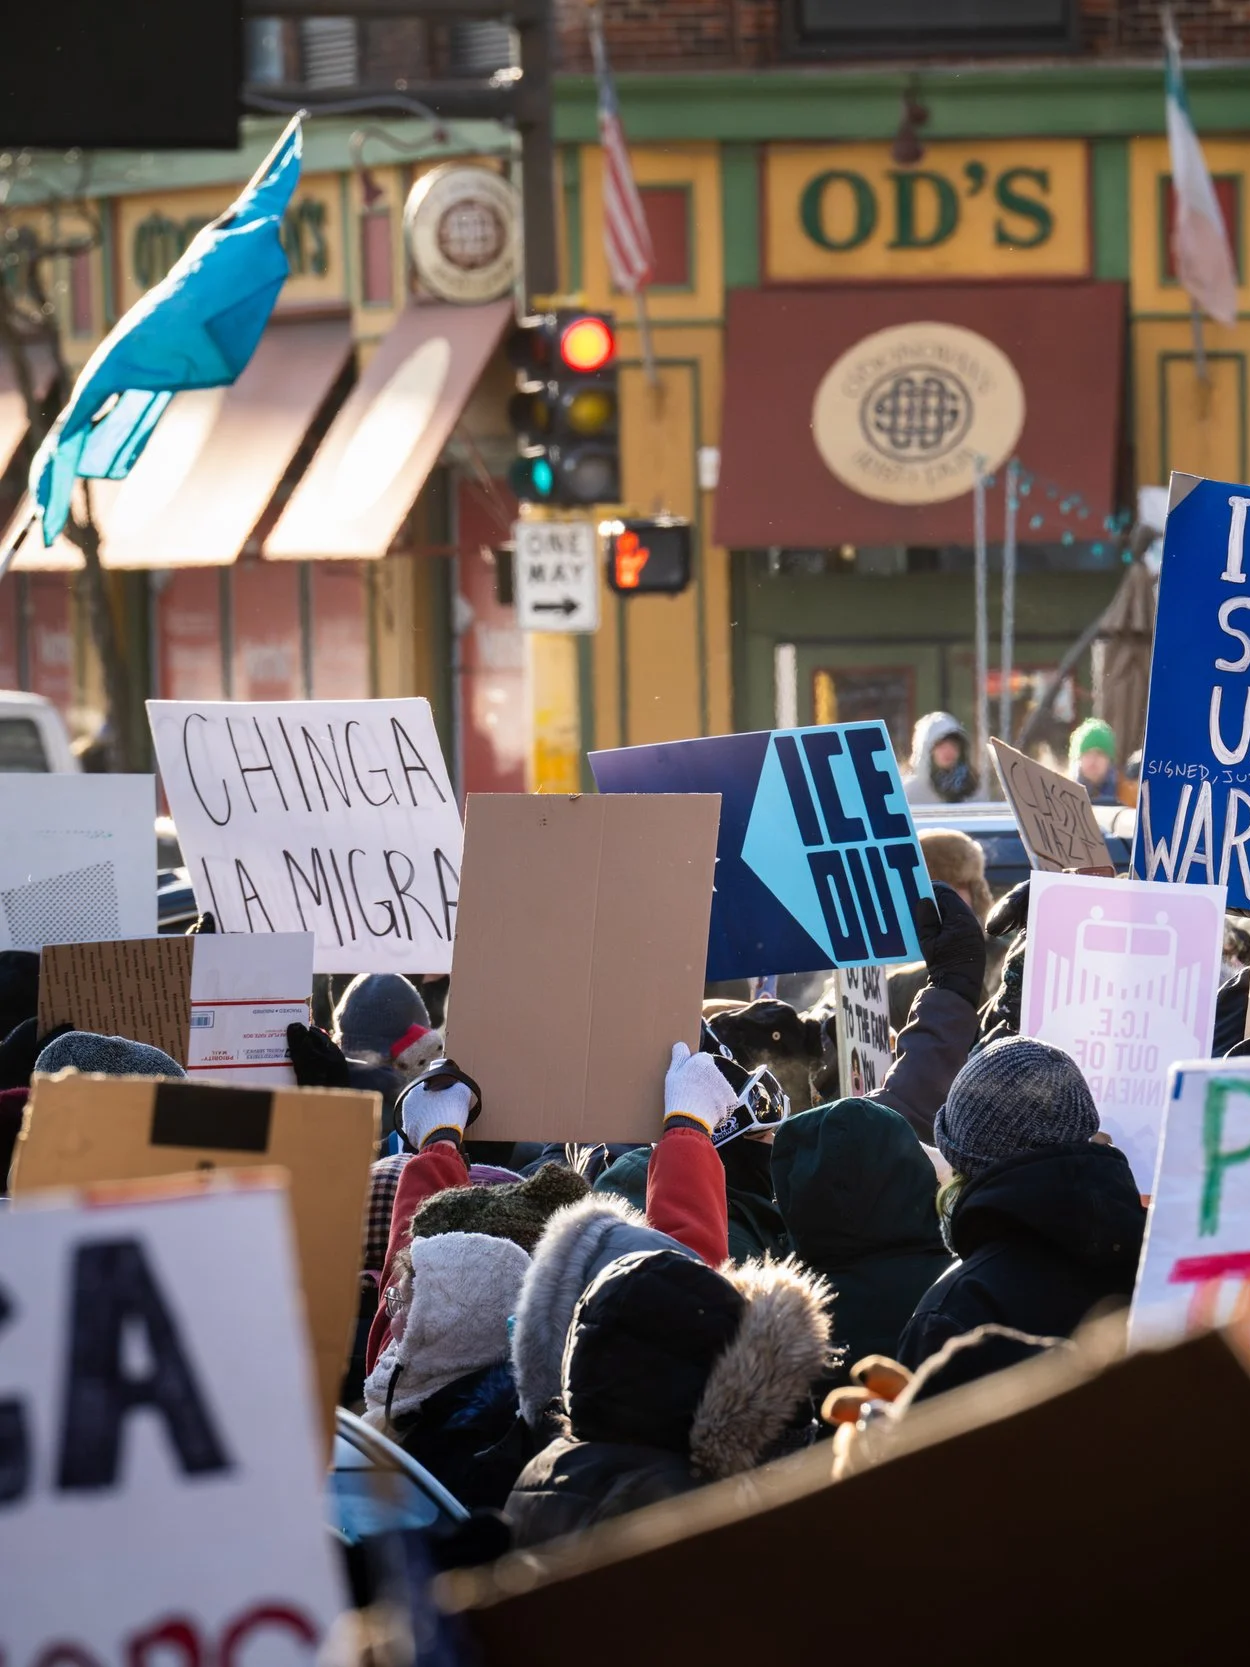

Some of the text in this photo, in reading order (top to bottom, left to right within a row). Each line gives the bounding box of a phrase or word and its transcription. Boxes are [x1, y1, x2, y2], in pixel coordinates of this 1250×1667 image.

[799, 160, 1055, 253] OD'S
[527, 532, 581, 556] ONE
[183, 713, 446, 826] CHINGA
[773, 727, 911, 847] ICE
[201, 856, 275, 934] LA
[282, 847, 460, 946] MIGRA
[806, 843, 922, 962] OUT
[842, 995, 854, 1039] TO
[855, 1003, 870, 1044] THE
